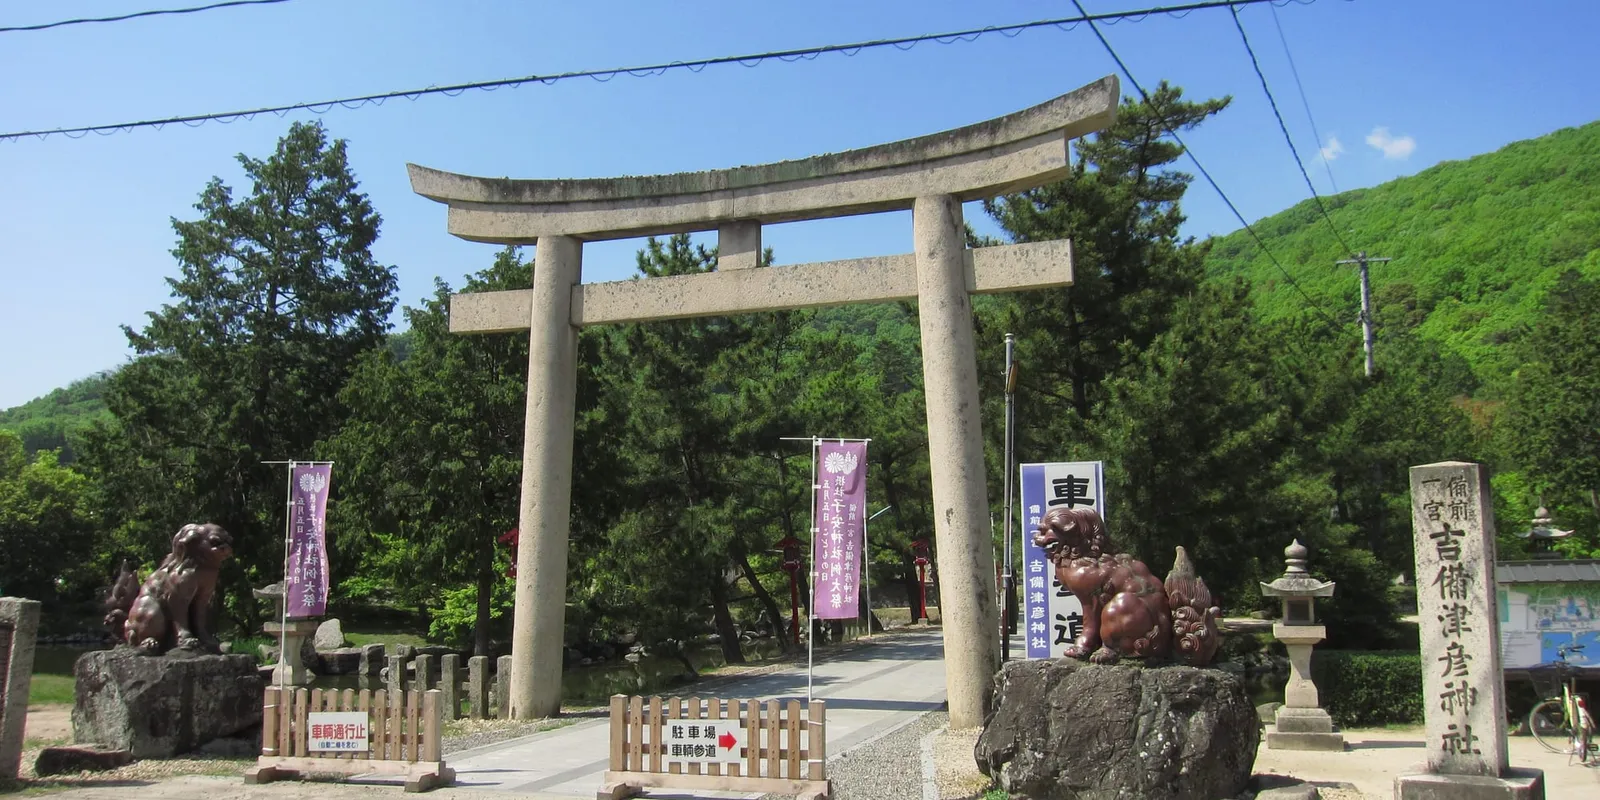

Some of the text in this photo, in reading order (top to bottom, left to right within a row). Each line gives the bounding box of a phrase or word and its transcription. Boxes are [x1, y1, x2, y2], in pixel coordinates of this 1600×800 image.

[1421, 478, 1444, 521] 一宮
[1447, 475, 1468, 521] 備前
[1029, 559, 1047, 649] 吉備津彦神社
[1430, 522, 1482, 756] 吉備津彦神社
[671, 725, 716, 739] 駐車場
